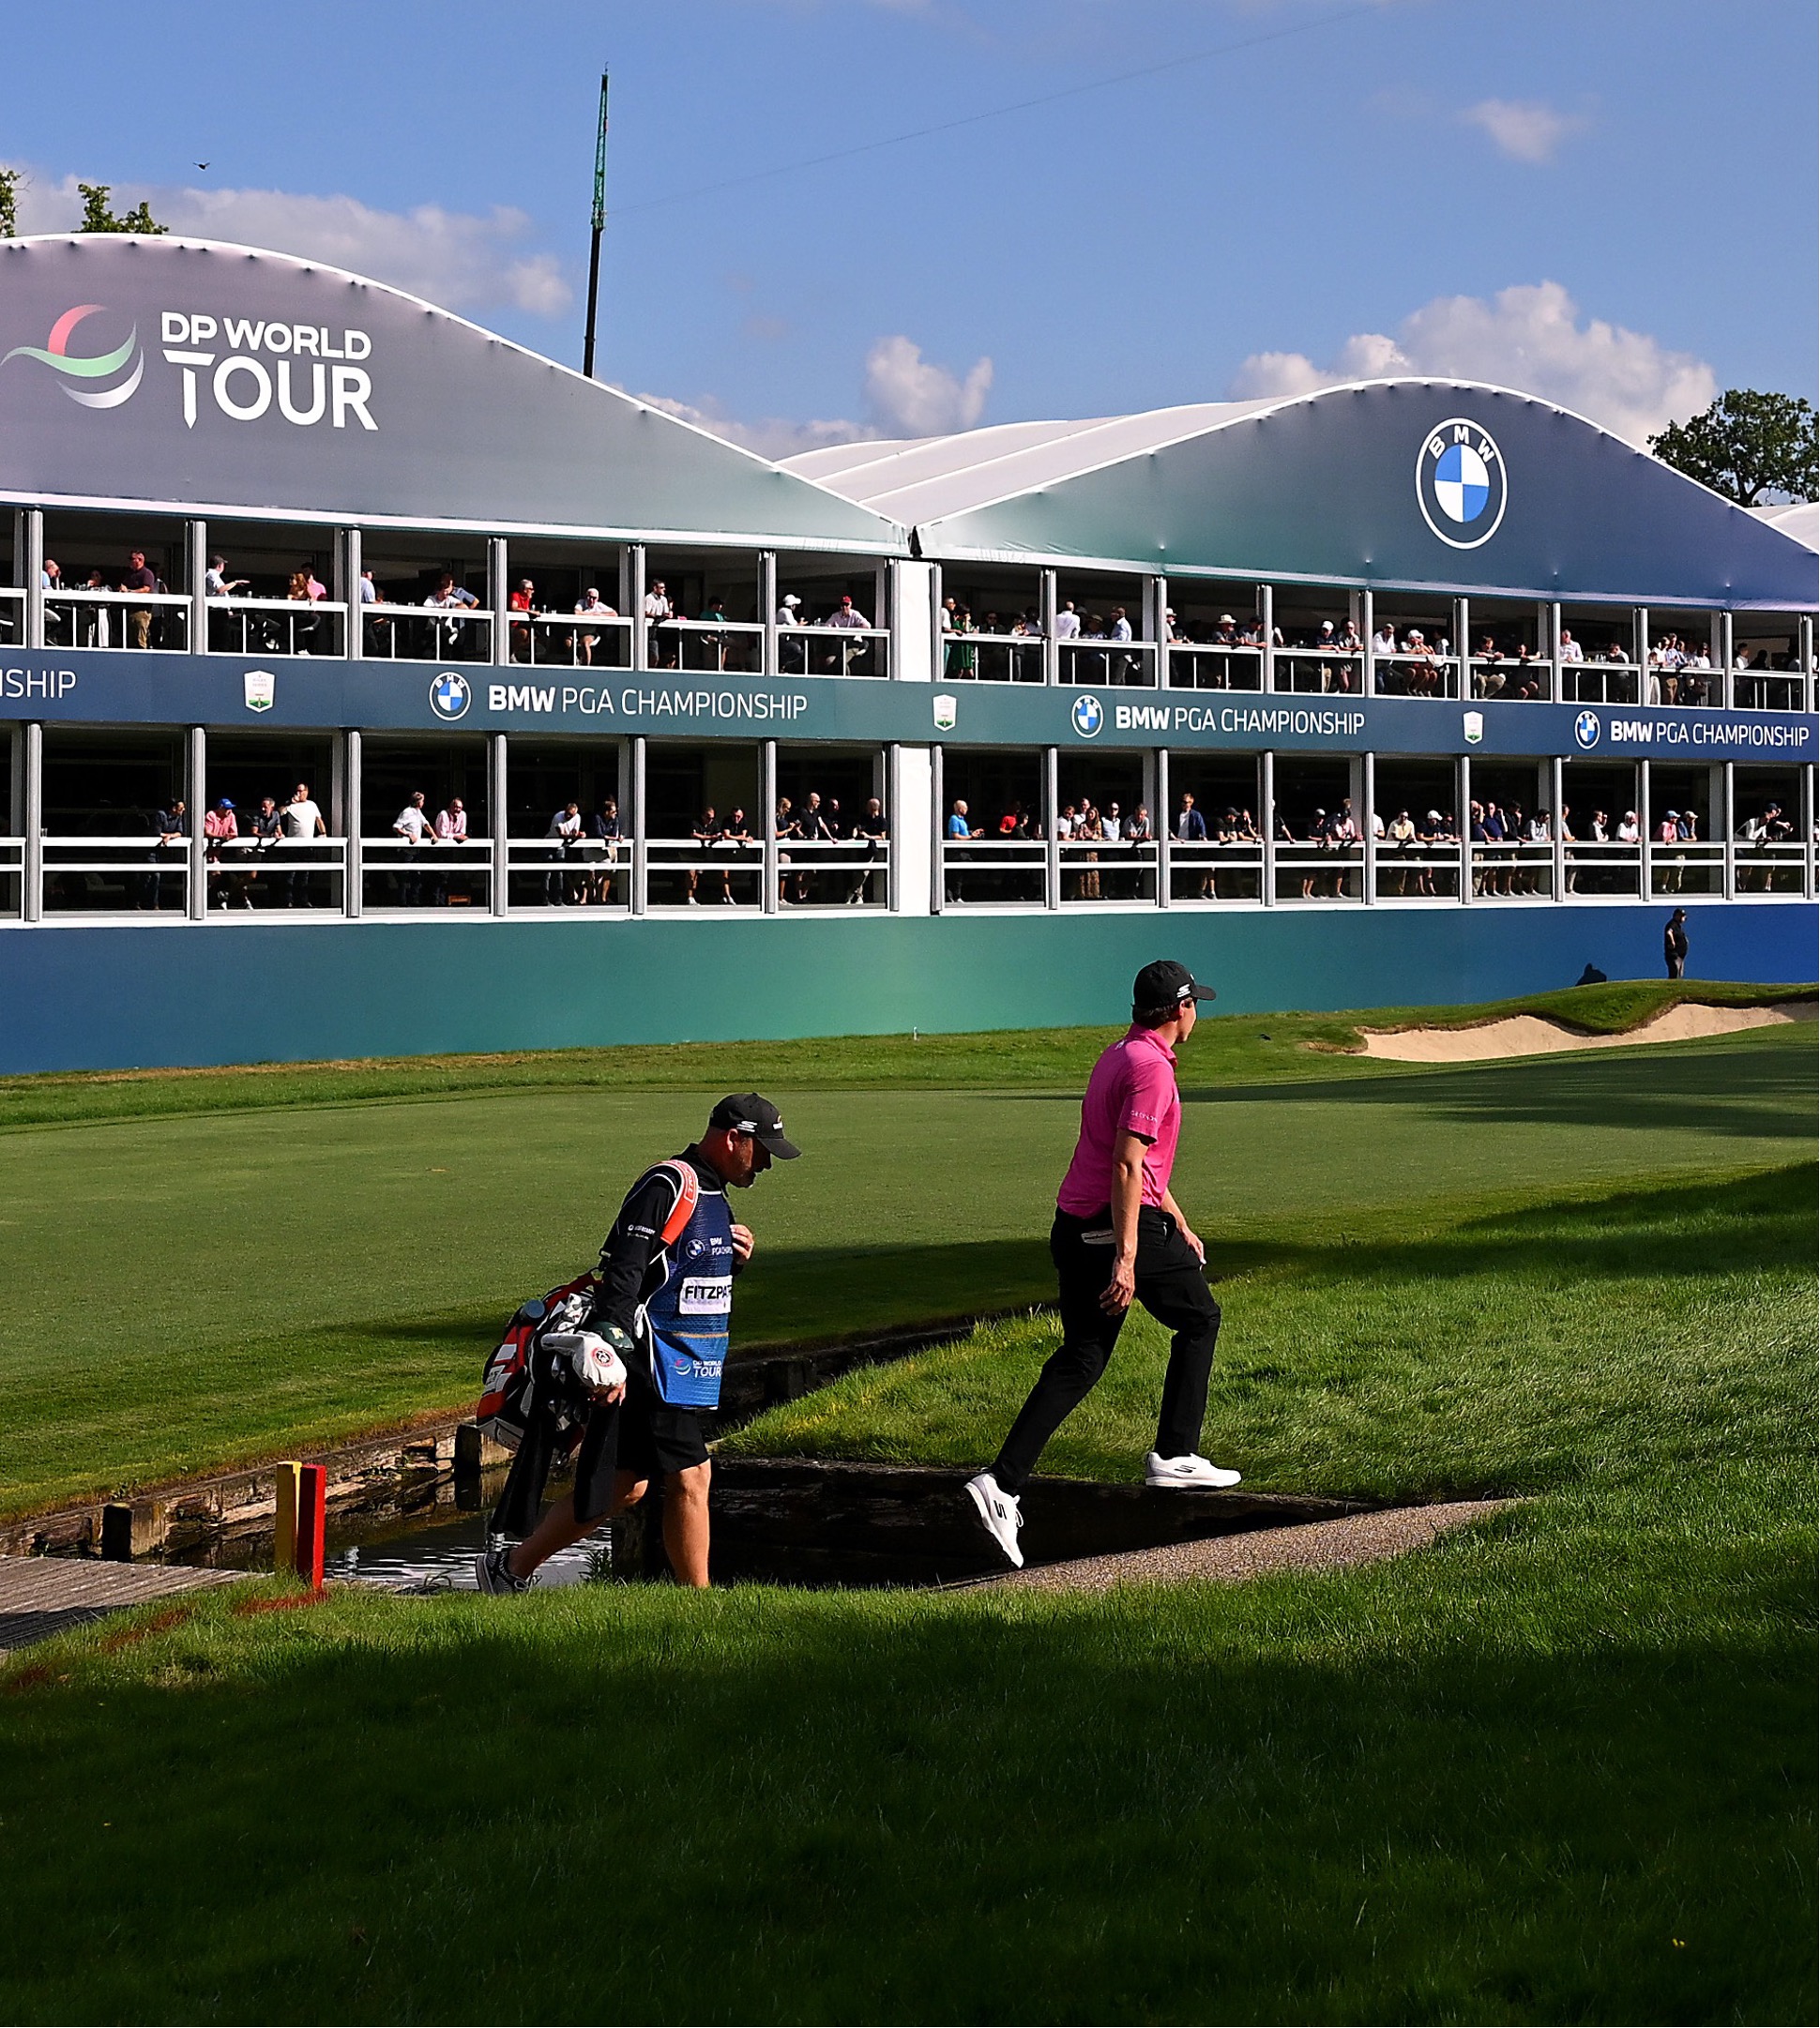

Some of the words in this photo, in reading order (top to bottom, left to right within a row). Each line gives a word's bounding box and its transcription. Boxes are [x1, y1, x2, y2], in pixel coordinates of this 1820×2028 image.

[161, 311, 218, 345] DP
[223, 317, 372, 360] WORLD
[162, 349, 379, 430] TOUR
[1428, 425, 1495, 462] BMW
[488, 685, 556, 712] BMW
[562, 687, 615, 715] PGA
[621, 689, 808, 719] CHAMPIONSHIP
[1115, 705, 1170, 730] BMW
[1175, 706, 1217, 732] PGA
[1221, 708, 1365, 735] CHAMPIONSHIP
[1610, 720, 1653, 743] BMW
[1656, 721, 1690, 744] PGA
[1692, 722, 1810, 747] CHAMPIONSHIP
[693, 1366, 722, 1378] TOUR
